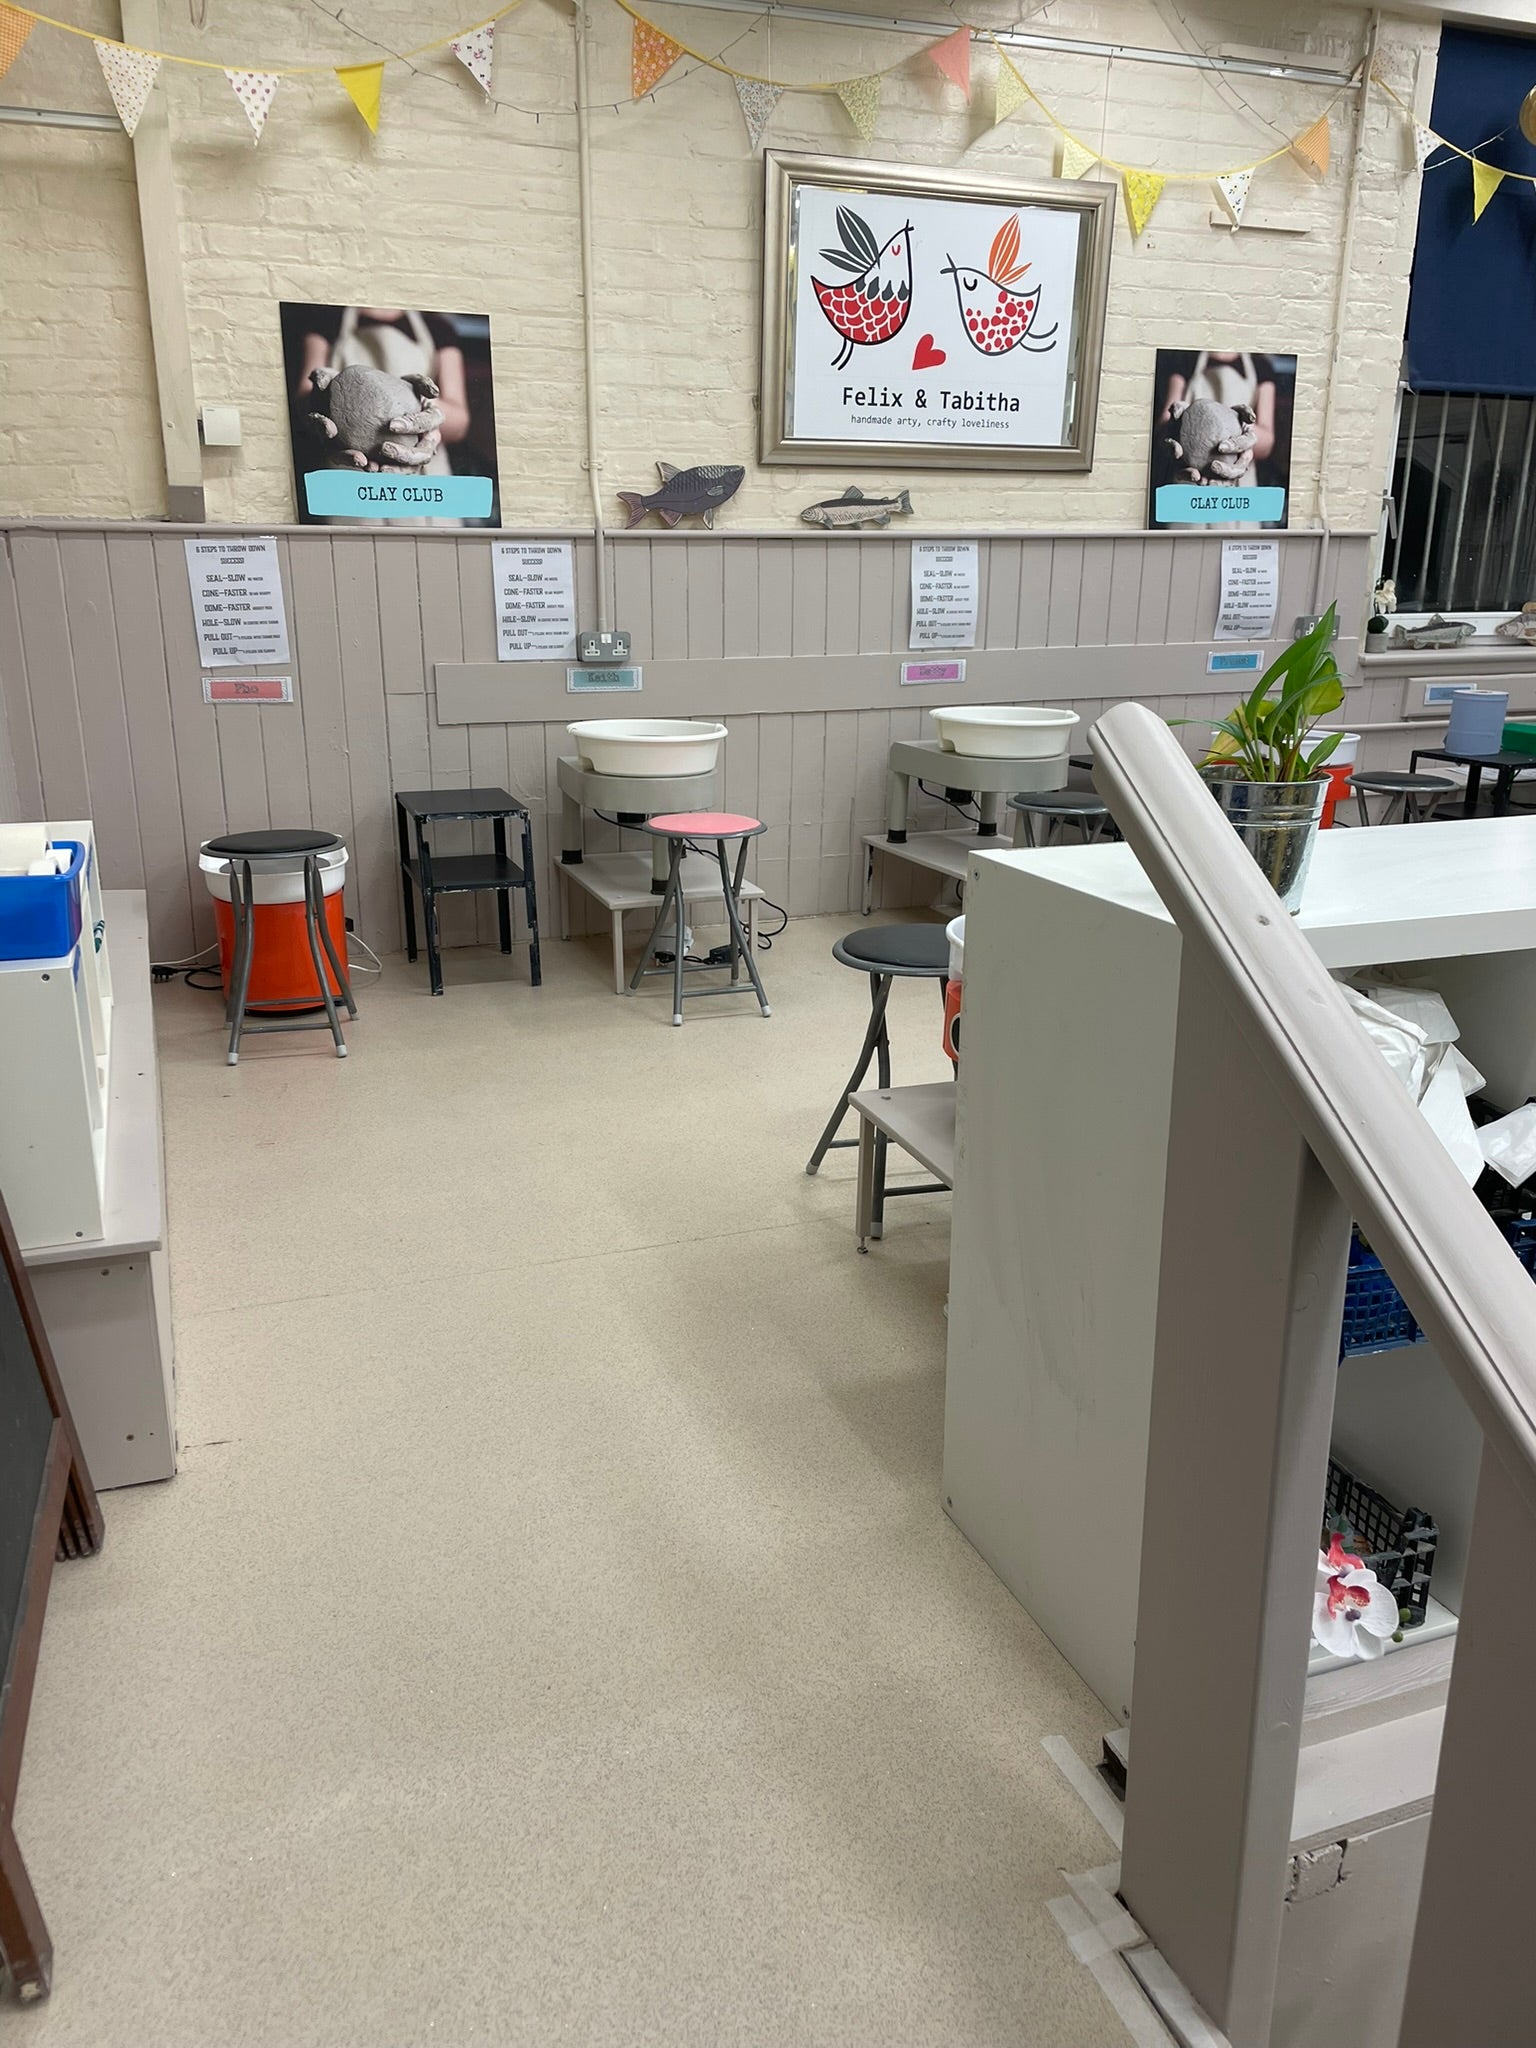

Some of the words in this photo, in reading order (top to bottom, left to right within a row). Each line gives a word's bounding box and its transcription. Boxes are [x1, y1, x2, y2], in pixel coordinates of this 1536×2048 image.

[842, 386, 903, 408] Felix
[915, 389, 928, 409] &
[940, 390, 1020, 412] Tabitha
[851, 414, 892, 425] handmade
[896, 416, 921, 428] arty,
[927, 417, 957, 429] crafty
[961, 418, 1010, 429] loveliness
[357, 486, 397, 501] CLAY
[402, 487, 444, 502] CLUB
[1190, 497, 1218, 509] CLAY
[1221, 497, 1250, 509] CLUB
[226, 545, 247, 553] THROW
[203, 633, 220, 641] PULL
[502, 629, 516, 637] PULL
[212, 647, 228, 655] PULL
